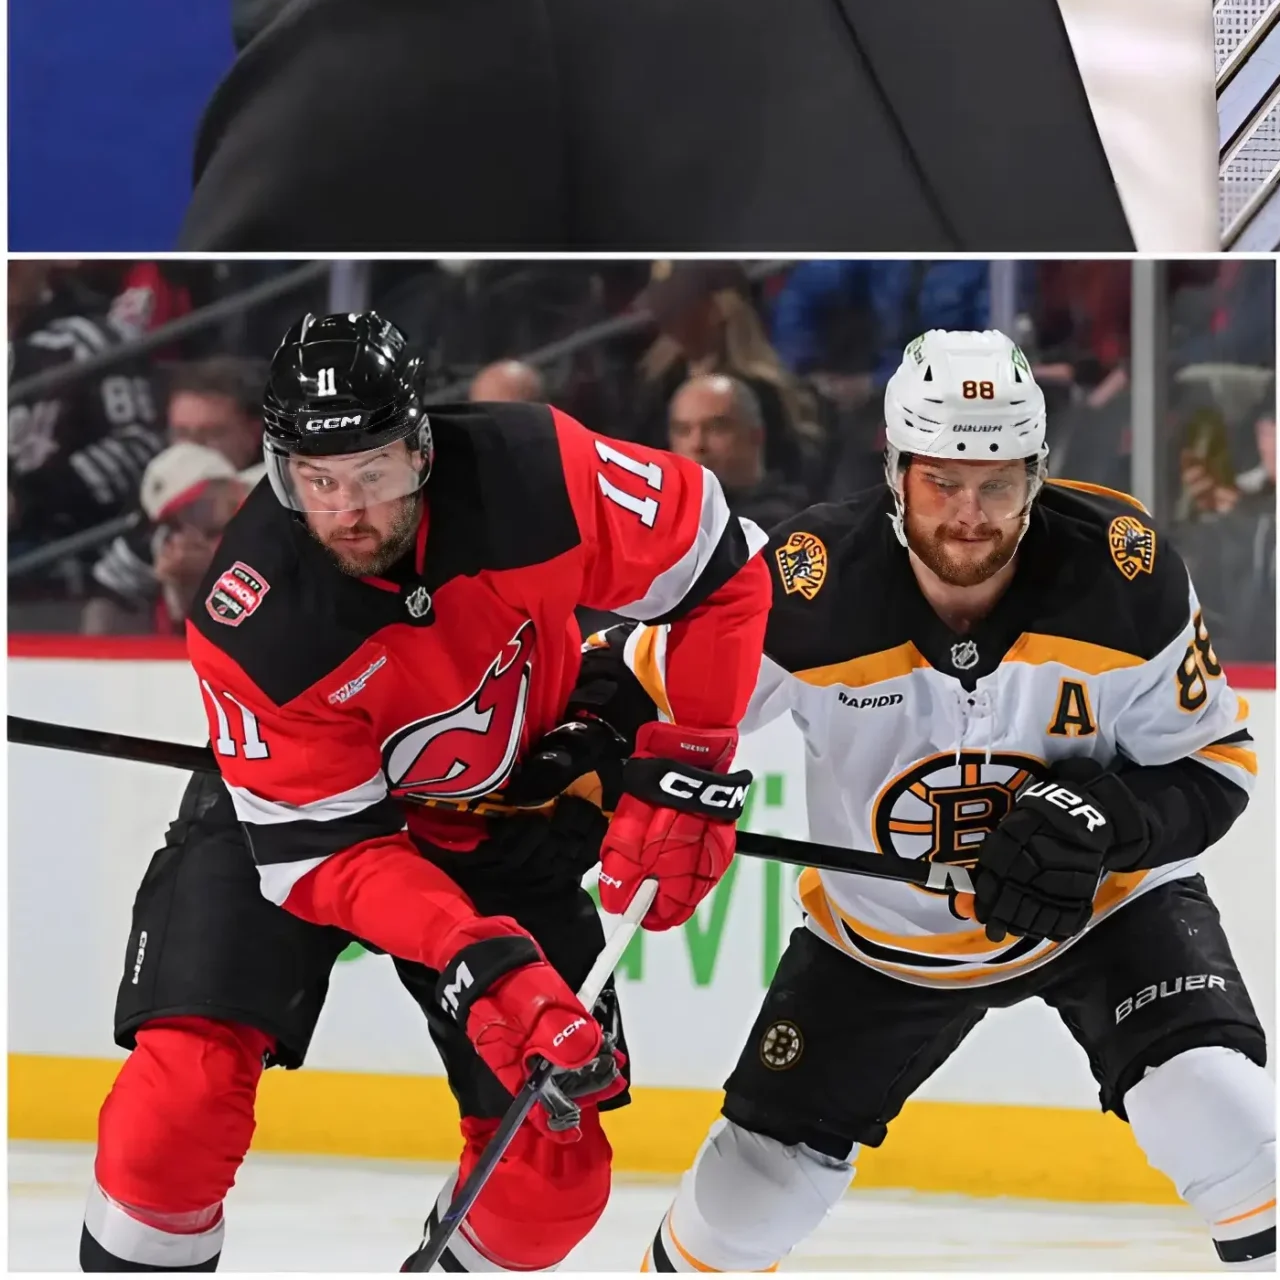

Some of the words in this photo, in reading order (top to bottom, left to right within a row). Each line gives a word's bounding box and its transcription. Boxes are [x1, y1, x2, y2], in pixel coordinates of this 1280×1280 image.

[317, 367, 338, 397] 11
[962, 380, 995, 400] 88
[306, 414, 362, 431] CCM
[594, 439, 664, 529] 11
[789, 534, 824, 598] BOSTON
[201, 677, 271, 761] 11
[1046, 676, 1097, 737] A
[1016, 781, 1107, 832] UER
[1115, 973, 1227, 1026] BAUER
